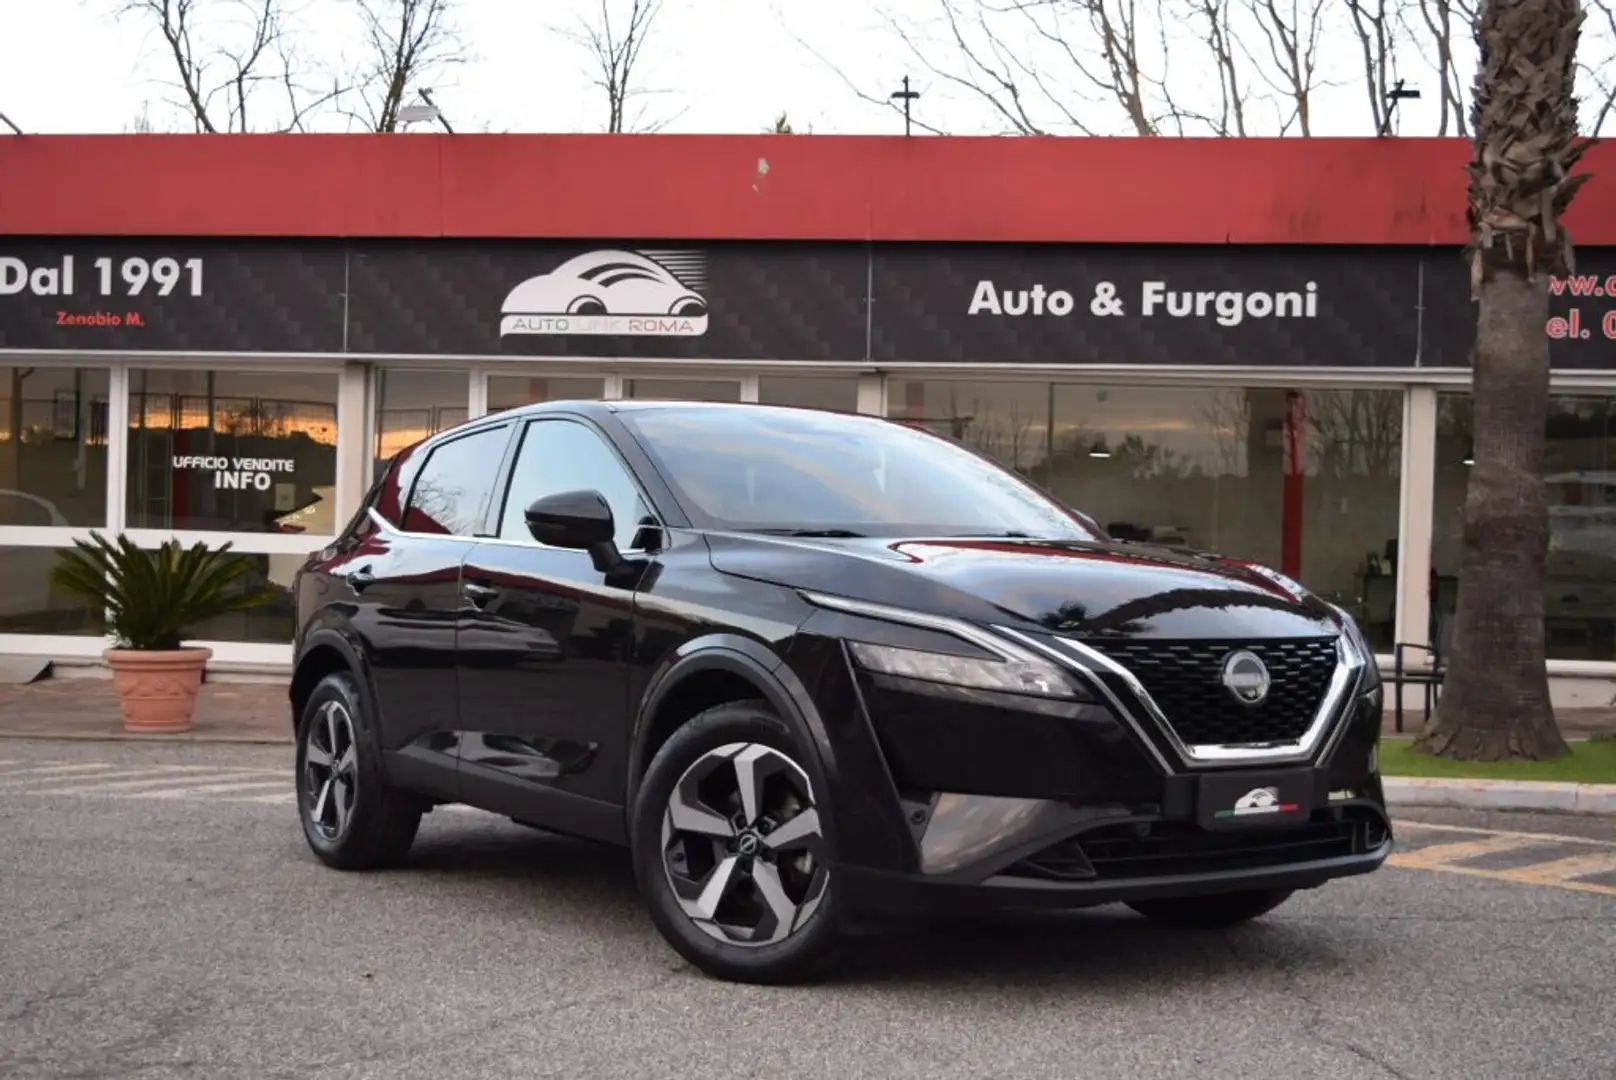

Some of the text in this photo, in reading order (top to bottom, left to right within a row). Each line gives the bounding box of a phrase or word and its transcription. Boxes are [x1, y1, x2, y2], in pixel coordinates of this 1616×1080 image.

[0, 255, 203, 296] Dal 1991
[968, 280, 1317, 326] Auto & Furgoni
[56, 311, 145, 326] Zenobio M.
[512, 318, 570, 332] AUTO
[628, 319, 694, 333] ROMA
[173, 456, 295, 472] UFFICIO VENDITE
[215, 471, 271, 490] INFO
